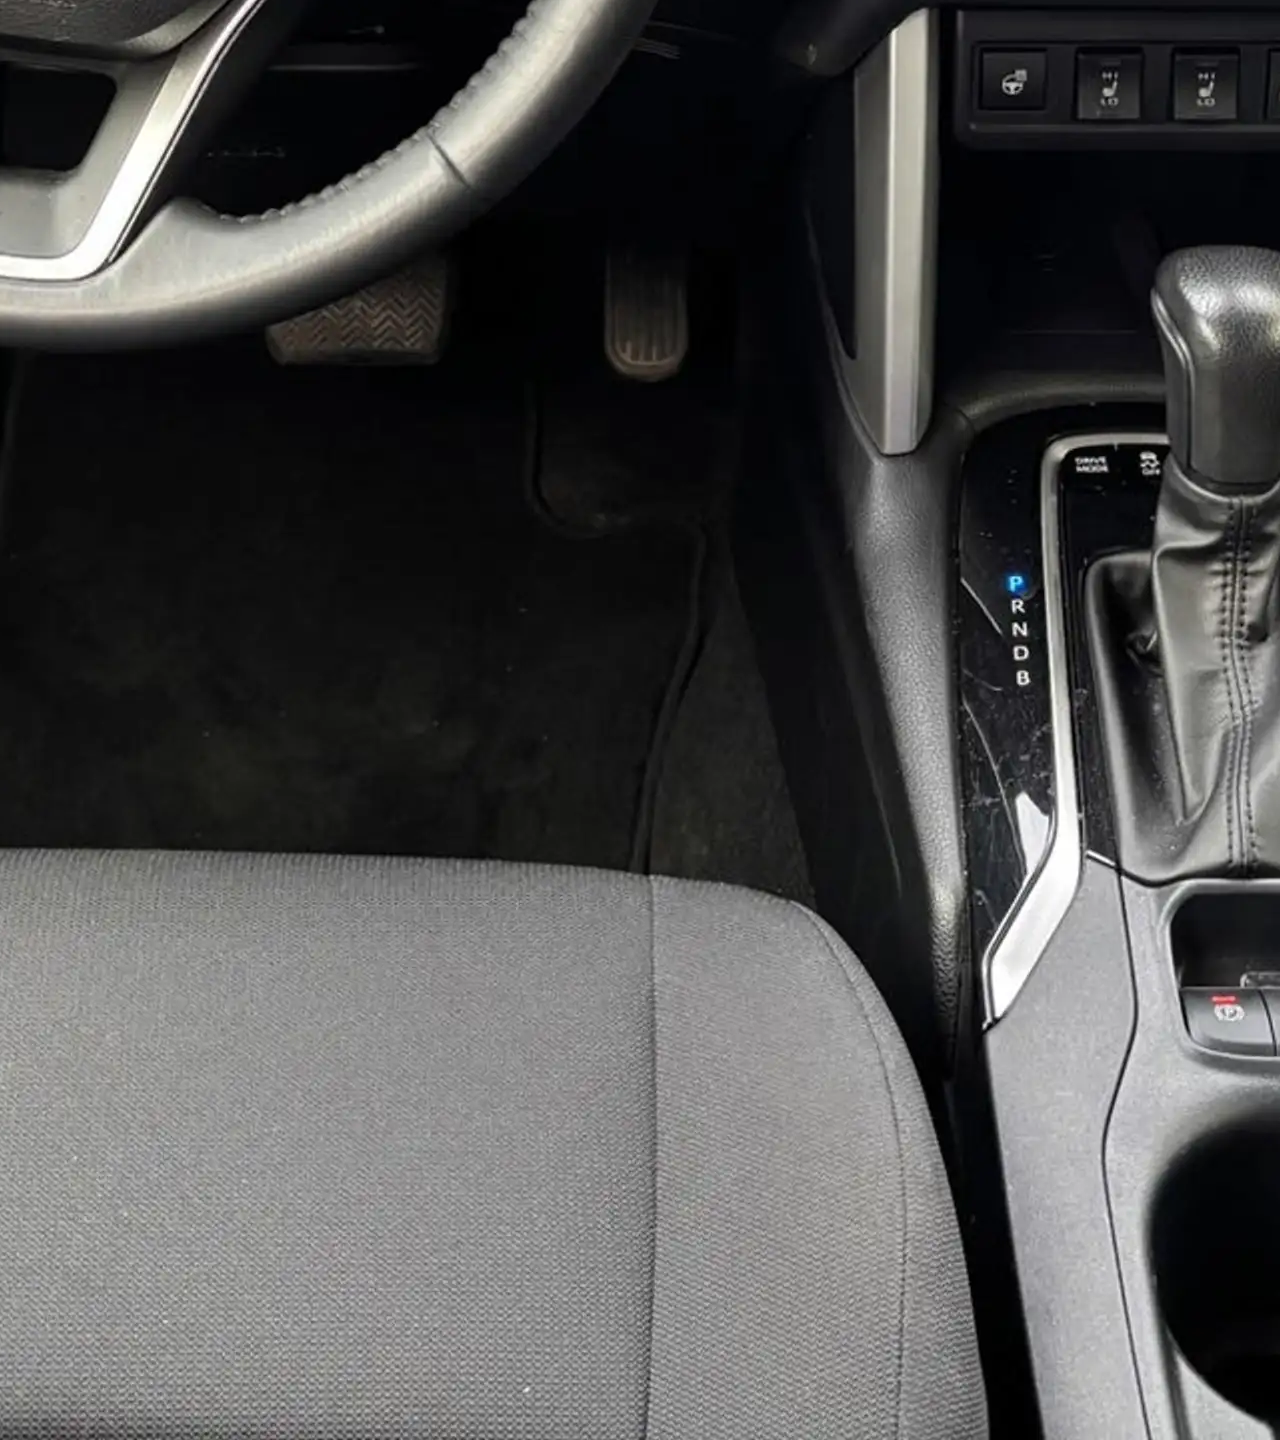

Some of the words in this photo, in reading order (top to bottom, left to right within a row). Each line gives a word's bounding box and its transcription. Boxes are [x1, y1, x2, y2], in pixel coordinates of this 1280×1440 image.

[1010, 576, 1022, 591] P
[1011, 599, 1026, 614] R
[1012, 622, 1028, 636] N
[1013, 646, 1029, 660] D
[1015, 670, 1030, 685] B
